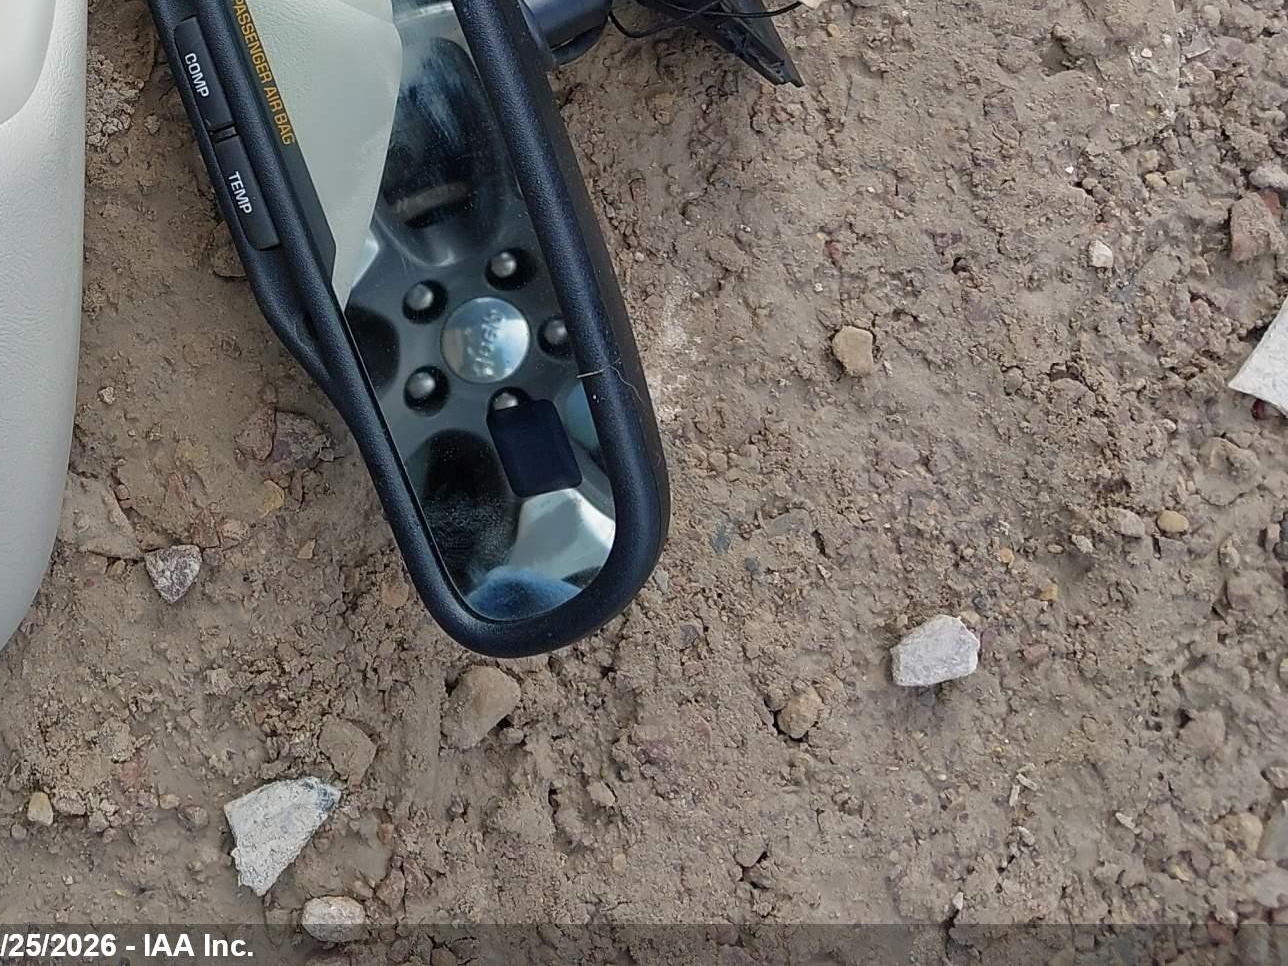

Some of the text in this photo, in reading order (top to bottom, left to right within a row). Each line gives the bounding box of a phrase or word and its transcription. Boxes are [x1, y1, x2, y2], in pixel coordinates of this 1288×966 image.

[184, 52, 210, 99] COMP
[264, 85, 283, 112] AIR
[274, 111, 296, 145] BAG
[228, 170, 253, 216] TEMP
